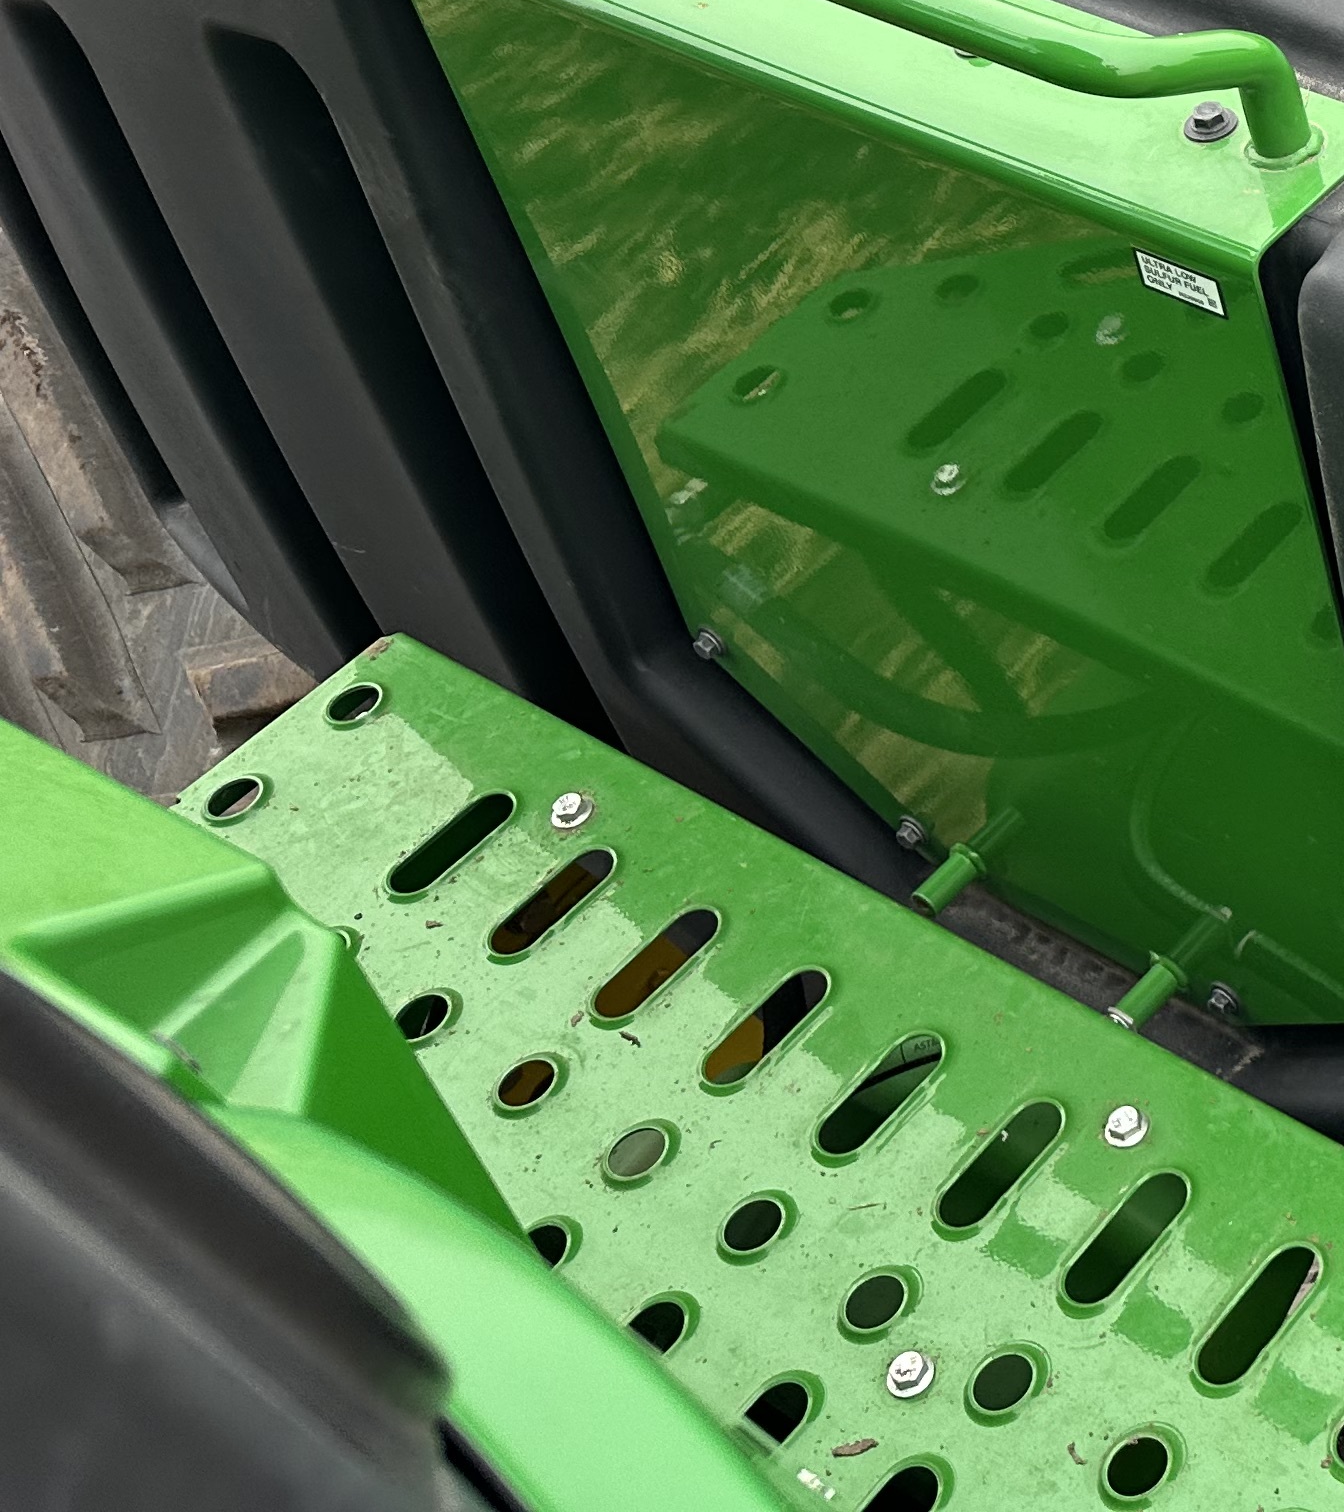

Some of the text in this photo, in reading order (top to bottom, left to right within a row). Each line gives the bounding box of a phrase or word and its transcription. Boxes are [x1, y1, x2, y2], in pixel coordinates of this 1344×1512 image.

[1141, 255, 1197, 283] ULTRA LOW
[1144, 265, 1210, 297] SULFUR FUEL
[1146, 275, 1173, 291] ONLY
